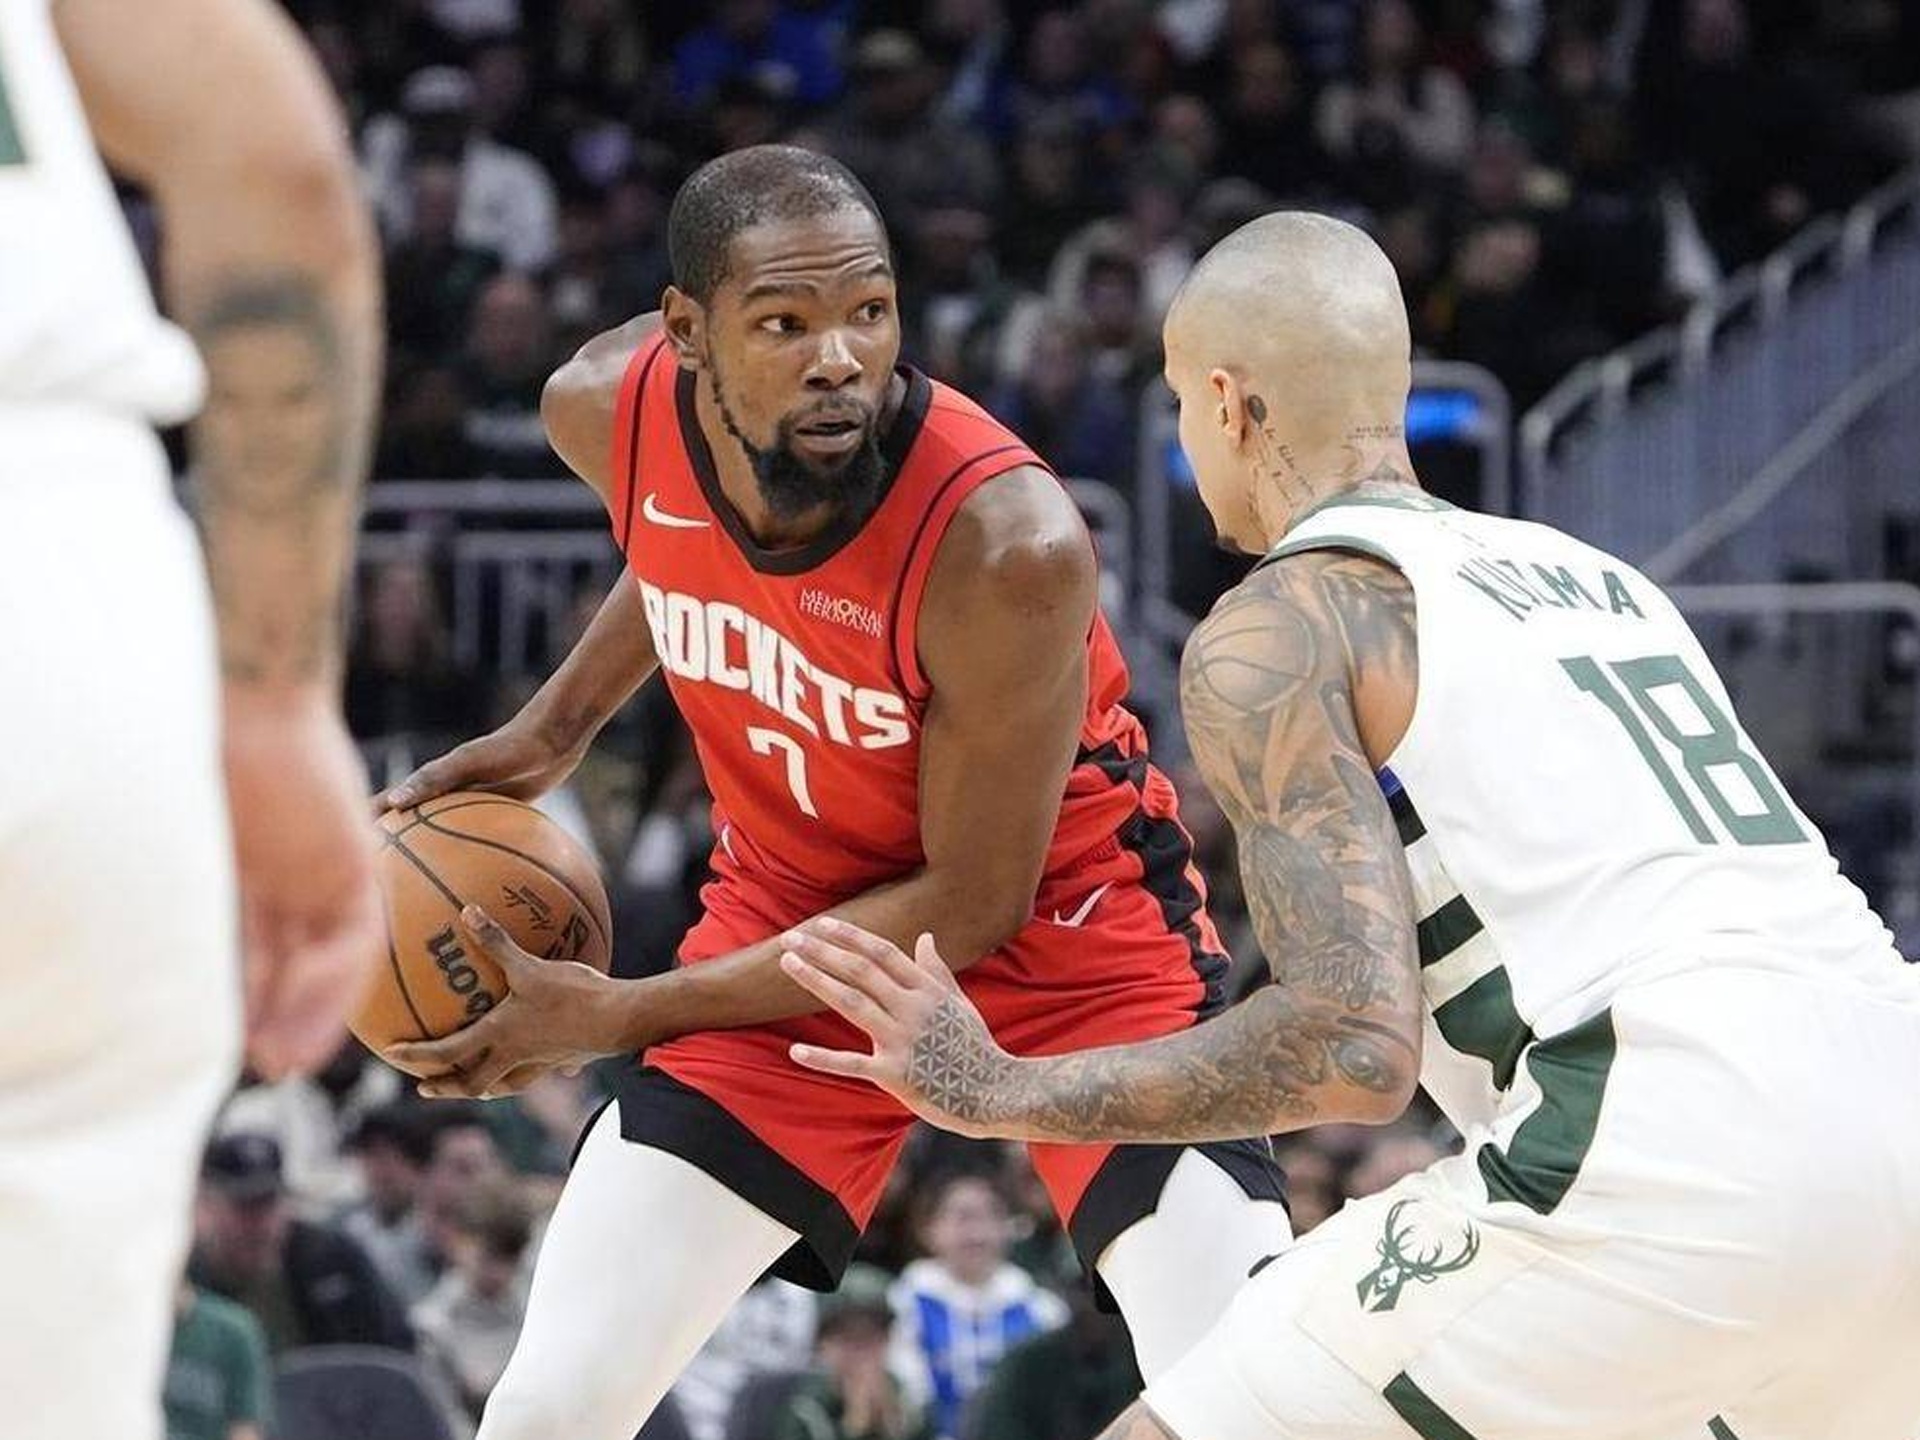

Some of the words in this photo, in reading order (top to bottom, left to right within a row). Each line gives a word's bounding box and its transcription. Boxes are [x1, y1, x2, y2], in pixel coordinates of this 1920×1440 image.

[799, 600, 882, 639] HERMANN
[801, 588, 883, 627] MEMORIAL
[1457, 556, 1647, 621] KUZMA
[638, 577, 911, 749] ROCKETS
[747, 726, 819, 819] 7
[1558, 655, 1812, 846] 18
